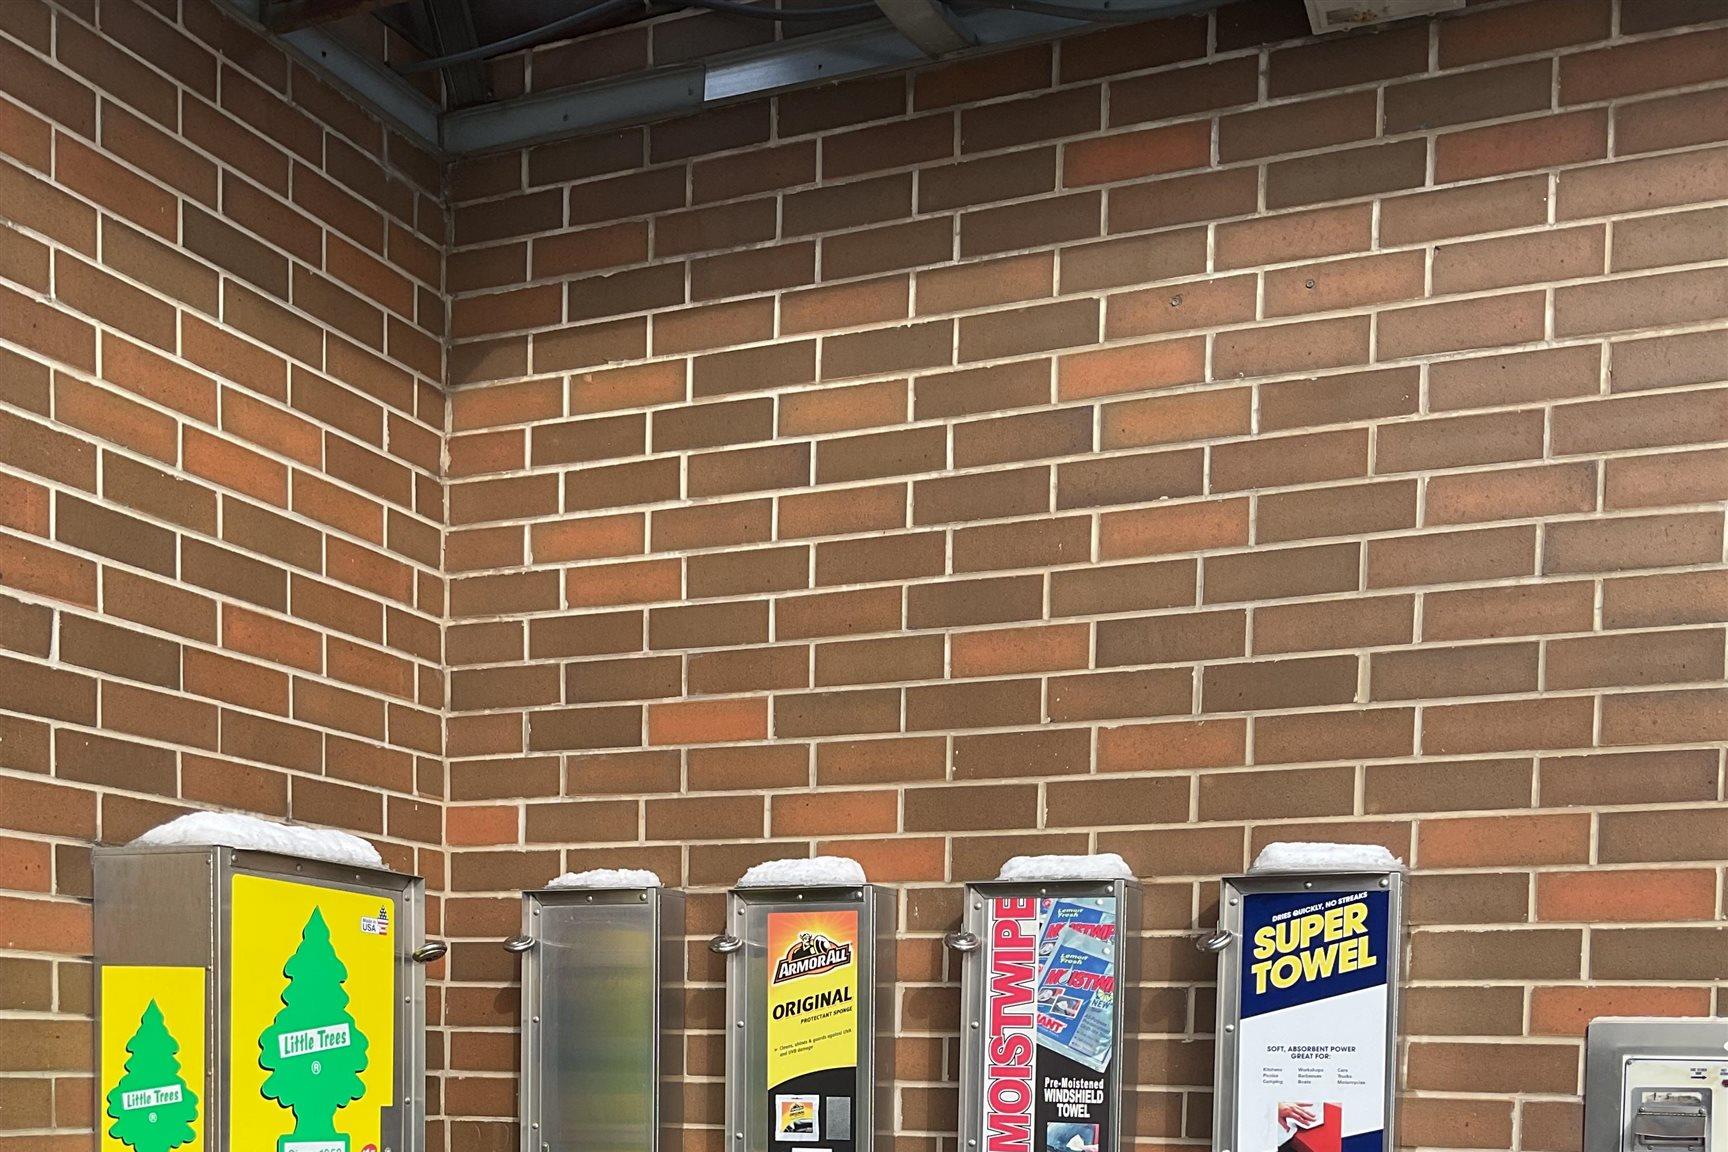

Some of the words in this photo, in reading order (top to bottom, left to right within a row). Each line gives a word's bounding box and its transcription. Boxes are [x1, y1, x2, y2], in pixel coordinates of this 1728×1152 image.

[1272, 911, 1292, 922] DRIES
[1292, 903, 1324, 917] QUICKLY,
[1325, 899, 1337, 909] NO
[1337, 891, 1368, 905] STREAKS
[362, 923, 377, 932] USA
[1253, 902, 1369, 959] SUPER
[1251, 935, 1377, 995] TOWEL
[772, 986, 853, 1020] ORIGINAL
[800, 1011, 833, 1024] PROTECTANT
[833, 1006, 853, 1017] SPONGE
[284, 1032, 314, 1055] Little
[317, 1029, 347, 1048] Trees
[1044, 1077, 1104, 1089] Pre-Moistened
[127, 1091, 152, 1108] Little
[154, 1089, 179, 1104] Trees
[1044, 1088, 1104, 1104] WINDSHIELD
[1057, 1103, 1091, 1118] TOWEL
